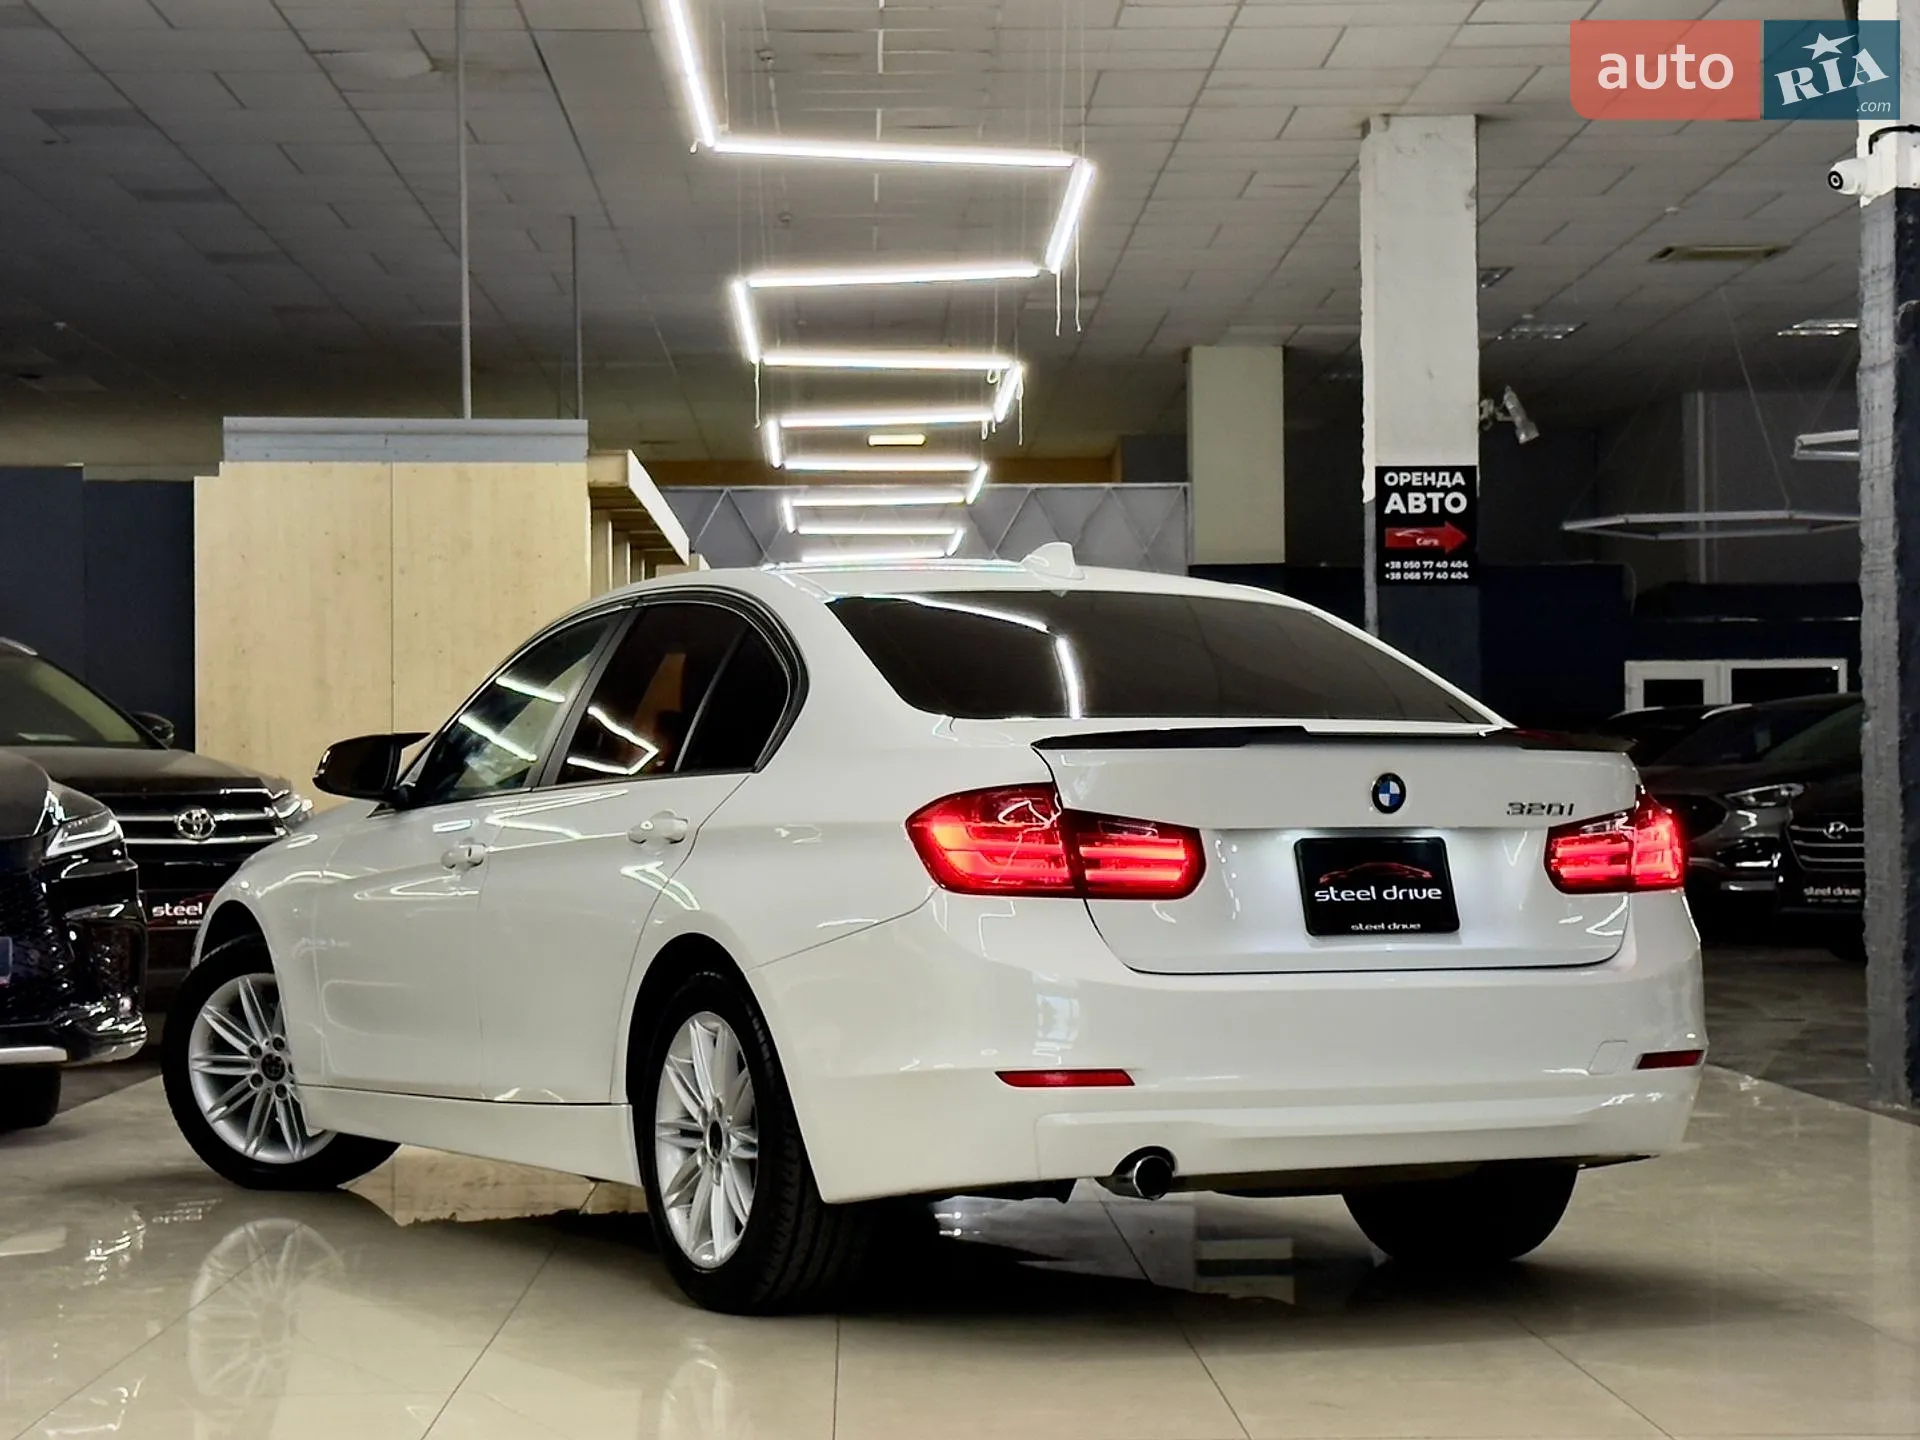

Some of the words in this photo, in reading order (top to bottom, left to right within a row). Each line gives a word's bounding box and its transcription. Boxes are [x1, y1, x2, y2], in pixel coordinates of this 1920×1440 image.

[1384, 471, 1466, 488] ОРЕНДА
[1384, 492, 1467, 514] АВТО
[1422, 561, 1434, 569] 77
[1436, 561, 1448, 569] 40
[1422, 572, 1434, 580] 77
[1436, 572, 1448, 580] 40
[1314, 885, 1377, 902] steel
[1382, 885, 1442, 901] drive
[152, 902, 204, 917] steel
[1351, 922, 1385, 931] steel
[1387, 922, 1421, 930] drive
